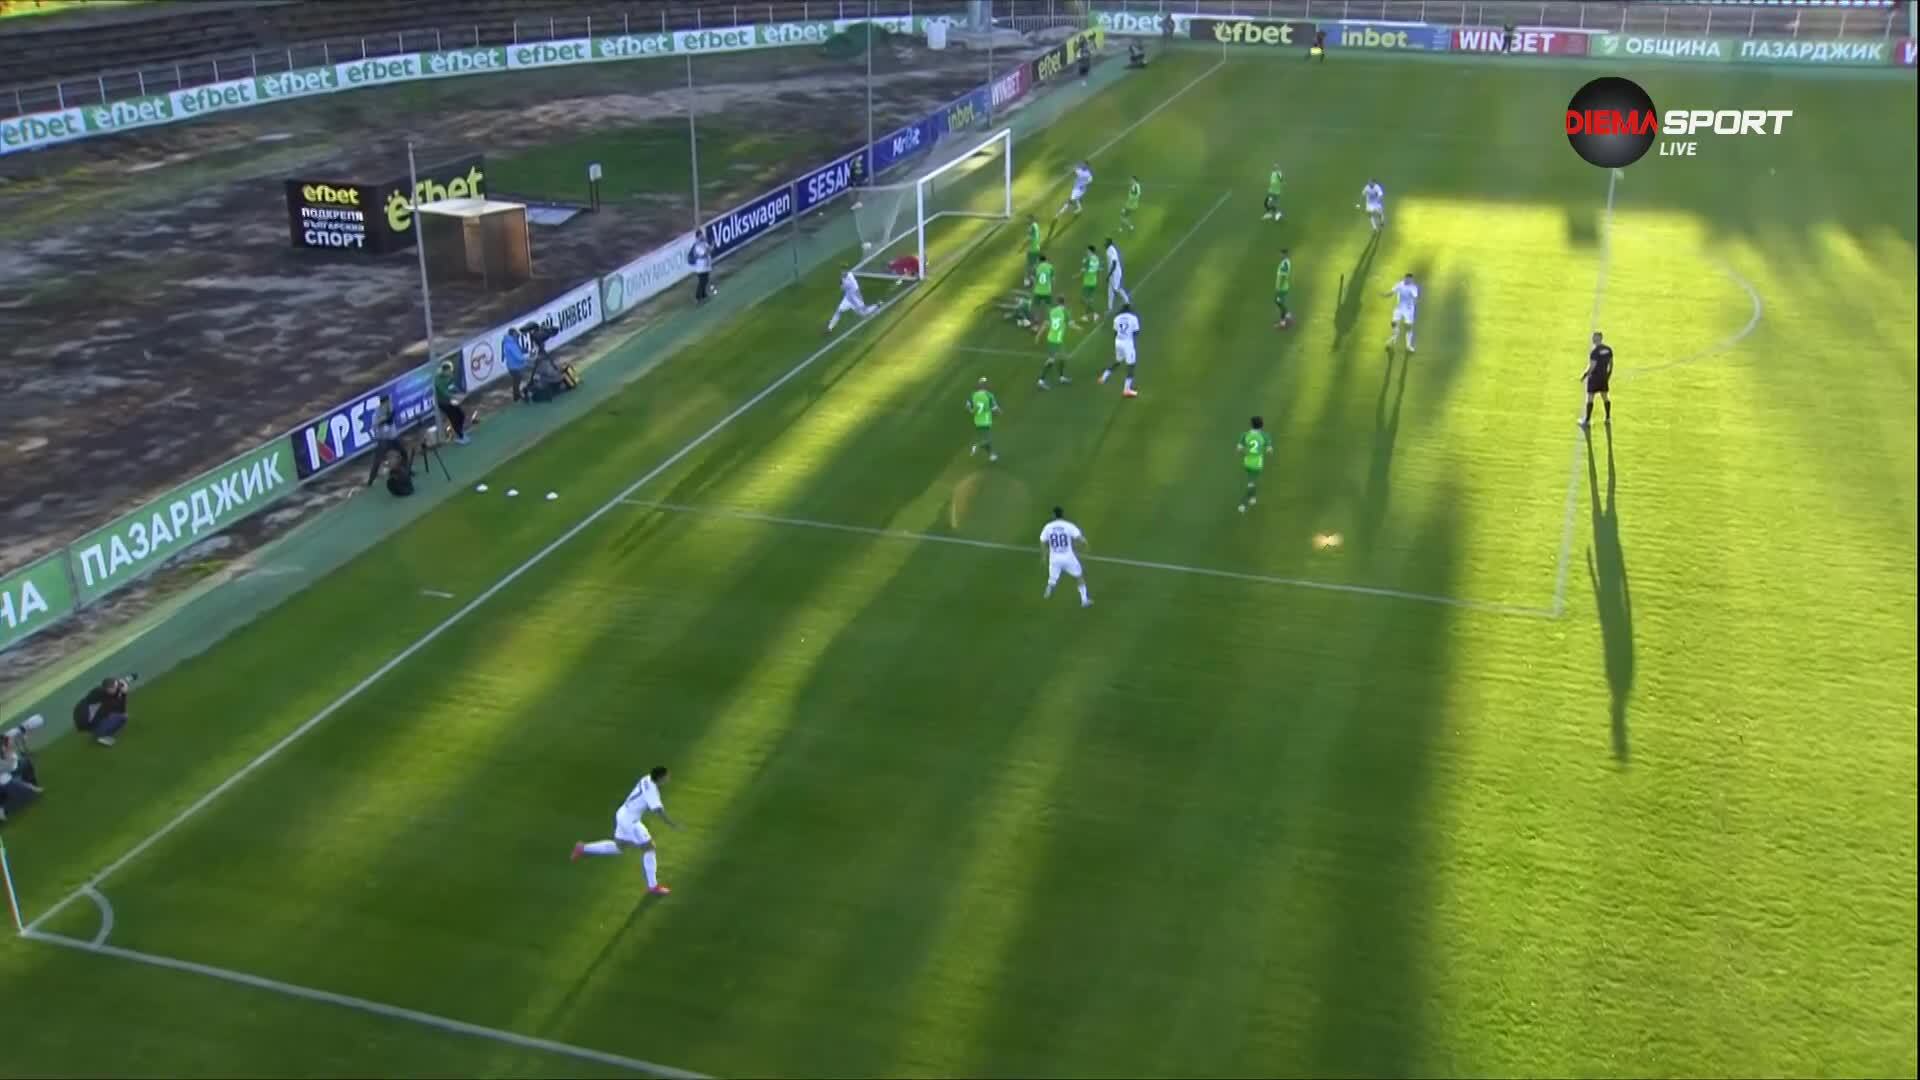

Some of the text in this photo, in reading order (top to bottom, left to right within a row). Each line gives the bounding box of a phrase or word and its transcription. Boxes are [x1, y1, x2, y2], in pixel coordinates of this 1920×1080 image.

[763, 22, 829, 43] efbet
[1096, 13, 1162, 32] efbet
[1213, 21, 1294, 44] efbet
[600, 34, 668, 56] efbet
[684, 29, 749, 49] efbet
[1625, 38, 1720, 58] ОБЩИНА
[1741, 41, 1884, 61] ПАЗАРДЖИК
[429, 48, 499, 72] efbet
[517, 42, 586, 64] efbet
[348, 57, 417, 82] efbet
[263, 69, 333, 94] efbet
[181, 84, 250, 113] efbet
[92, 97, 167, 129] efbet
[2, 113, 79, 146] efbet
[303, 184, 360, 206] efbet
[712, 193, 790, 247] Volkswagen
[305, 230, 366, 248] СПОРТ
[80, 452, 285, 586] ПАЗАРДЖИК
[1050, 533, 1069, 548] 88
